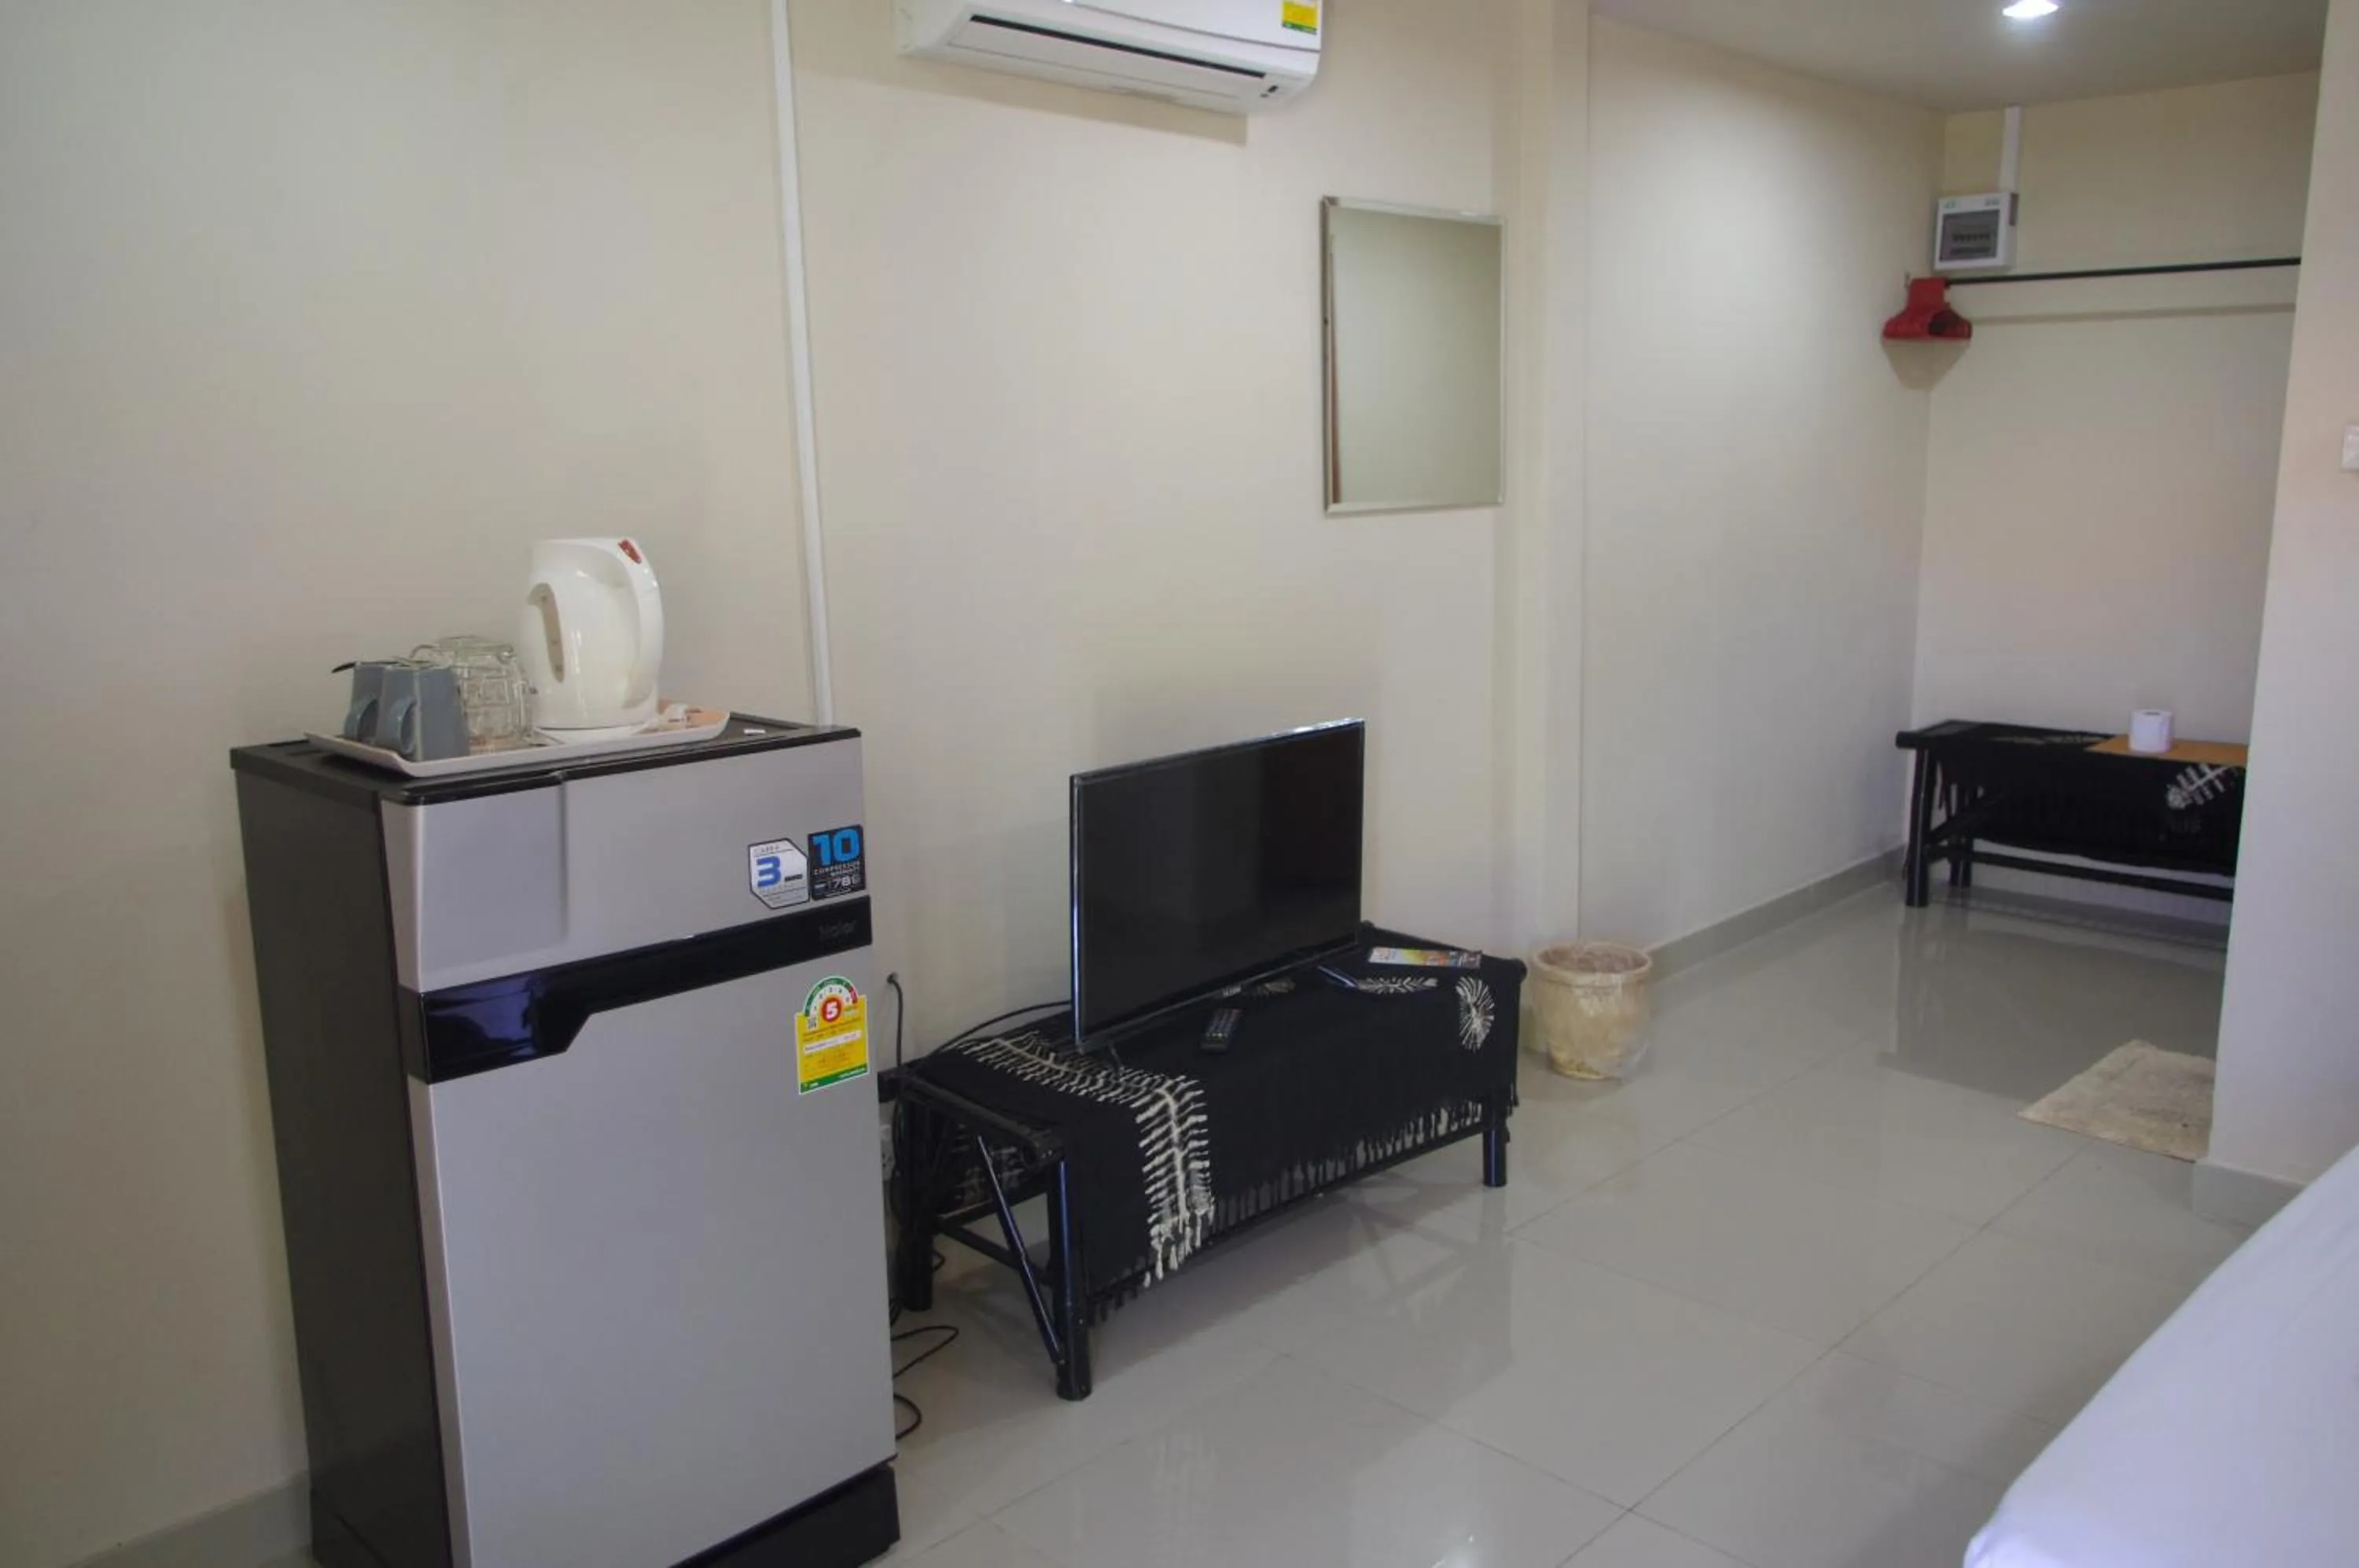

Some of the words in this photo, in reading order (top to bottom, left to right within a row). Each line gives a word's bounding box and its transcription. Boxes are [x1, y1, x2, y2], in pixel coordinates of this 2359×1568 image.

[813, 828, 859, 867] 10
[756, 856, 781, 888] 3
[826, 1001, 837, 1020] 5
